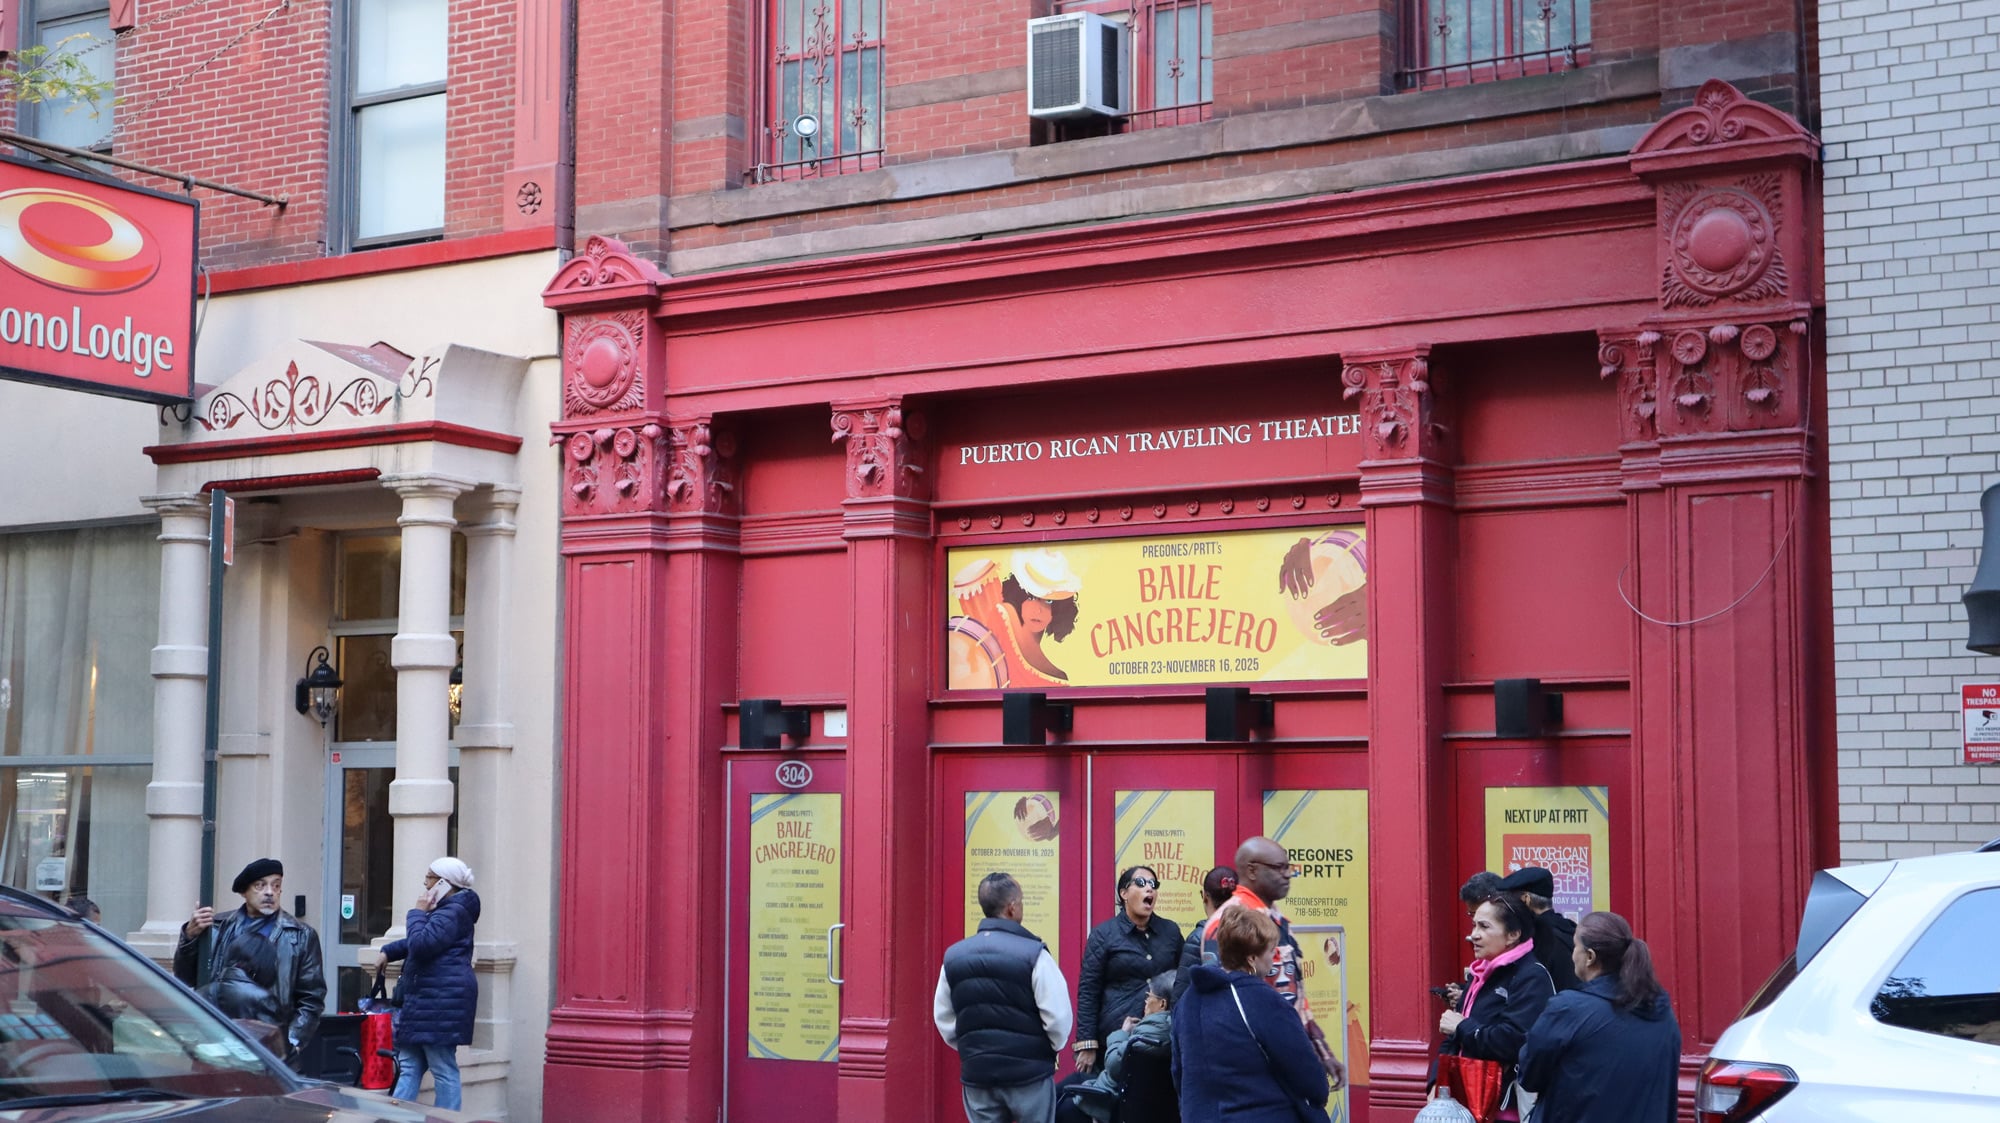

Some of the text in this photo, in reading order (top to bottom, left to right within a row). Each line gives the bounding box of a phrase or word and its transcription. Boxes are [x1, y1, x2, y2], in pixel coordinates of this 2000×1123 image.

[960, 441, 1042, 465] PUERTO
[1049, 435, 1119, 459] RICAN
[1125, 424, 1251, 452] TRAVELING
[1142, 541, 1222, 558] PREGONES/PRTT's
[1138, 564, 1222, 603] BAILE
[1090, 607, 1278, 658] CANGREJERO
[1109, 657, 1259, 675] OCTOBER 23-NOVEMBER 16, 2025
[1982, 688, 1997, 698] NO
[782, 766, 806, 783] 304
[1505, 809, 1588, 823] NEXT UP AT PRTT
[776, 820, 813, 839] BAILE
[755, 841, 836, 864] CANGREJERO
[971, 848, 993, 857] OCTOBER
[1041, 848, 1055, 857] 2025
[1143, 842, 1184, 860] BAILE
[1287, 848, 1353, 862] REGONES
[1303, 864, 1345, 878] PRTT
[1571, 896, 1590, 905] SLAM
